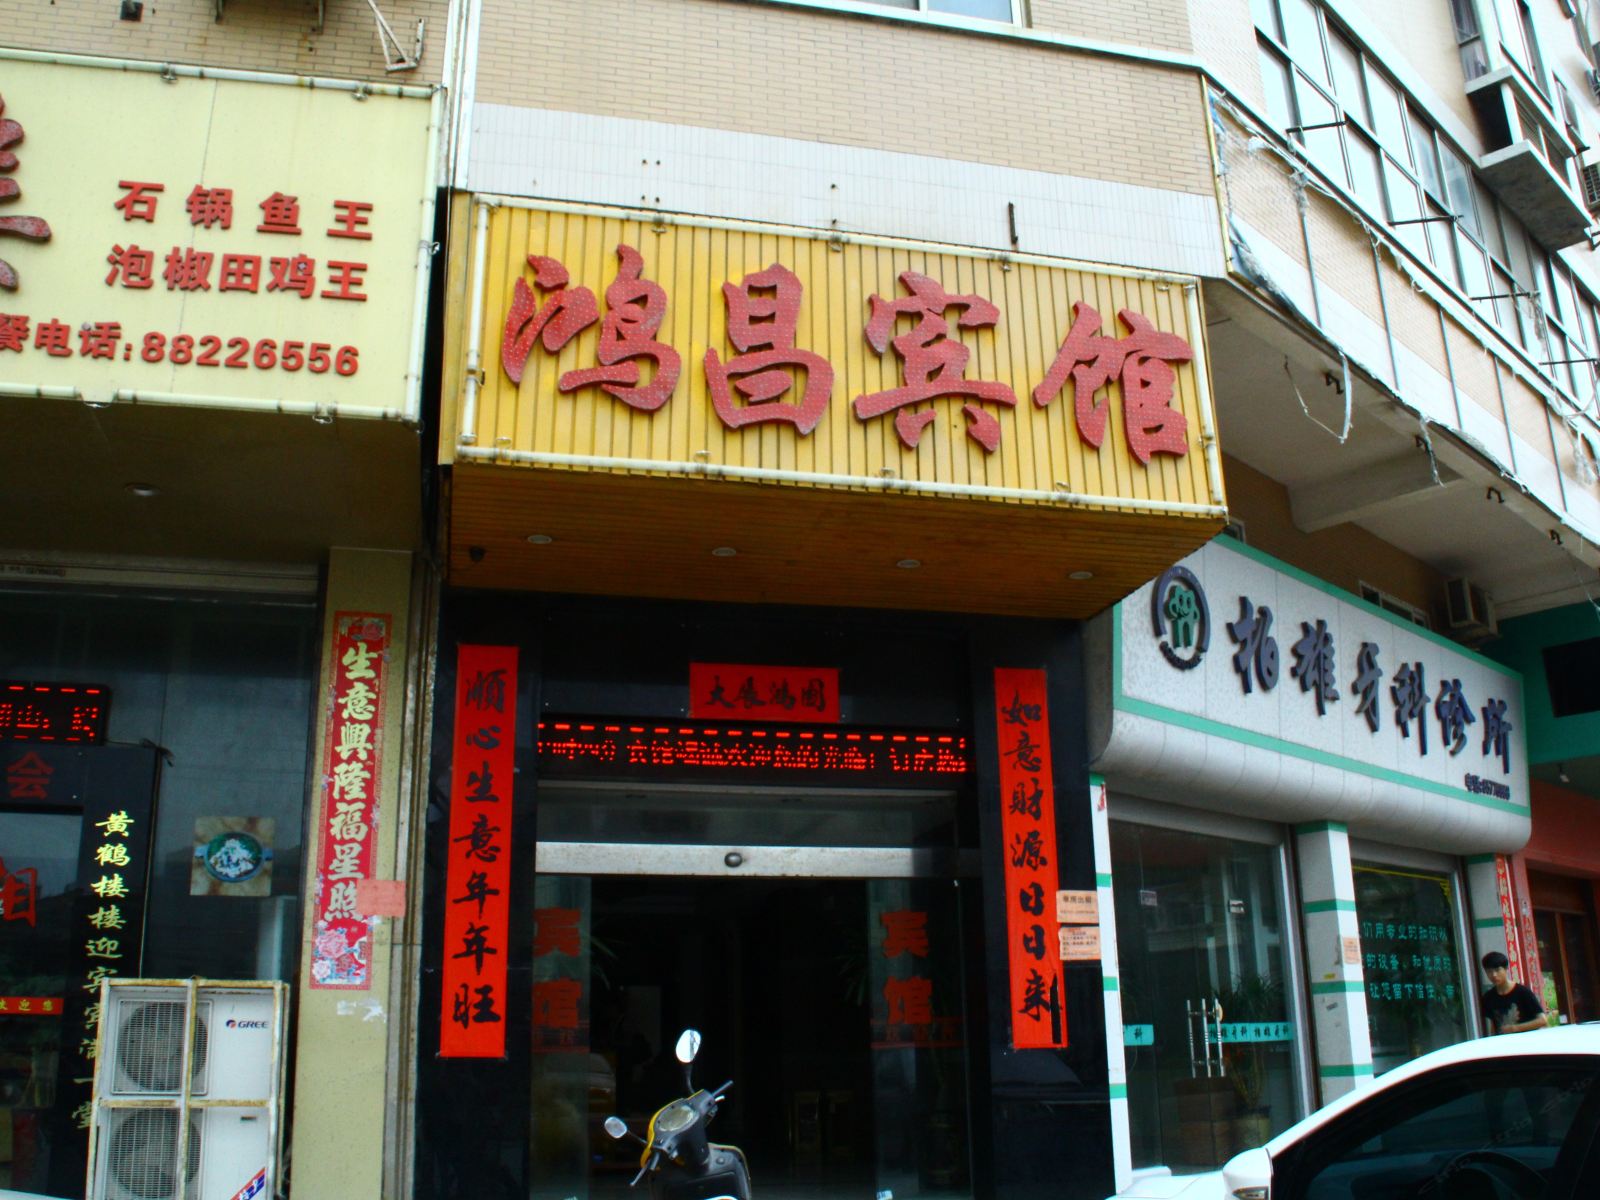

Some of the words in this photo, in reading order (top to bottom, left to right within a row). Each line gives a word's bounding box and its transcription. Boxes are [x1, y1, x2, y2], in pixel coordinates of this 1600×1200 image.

[114, 180, 373, 241] 石锅鱼王
[106, 244, 368, 301] 泡椒田鸡王
[501, 242, 1194, 466] 鸿昌宾馆
[880, 908, 934, 1025] 宾馆
[238, 1020, 269, 1029] GREE
